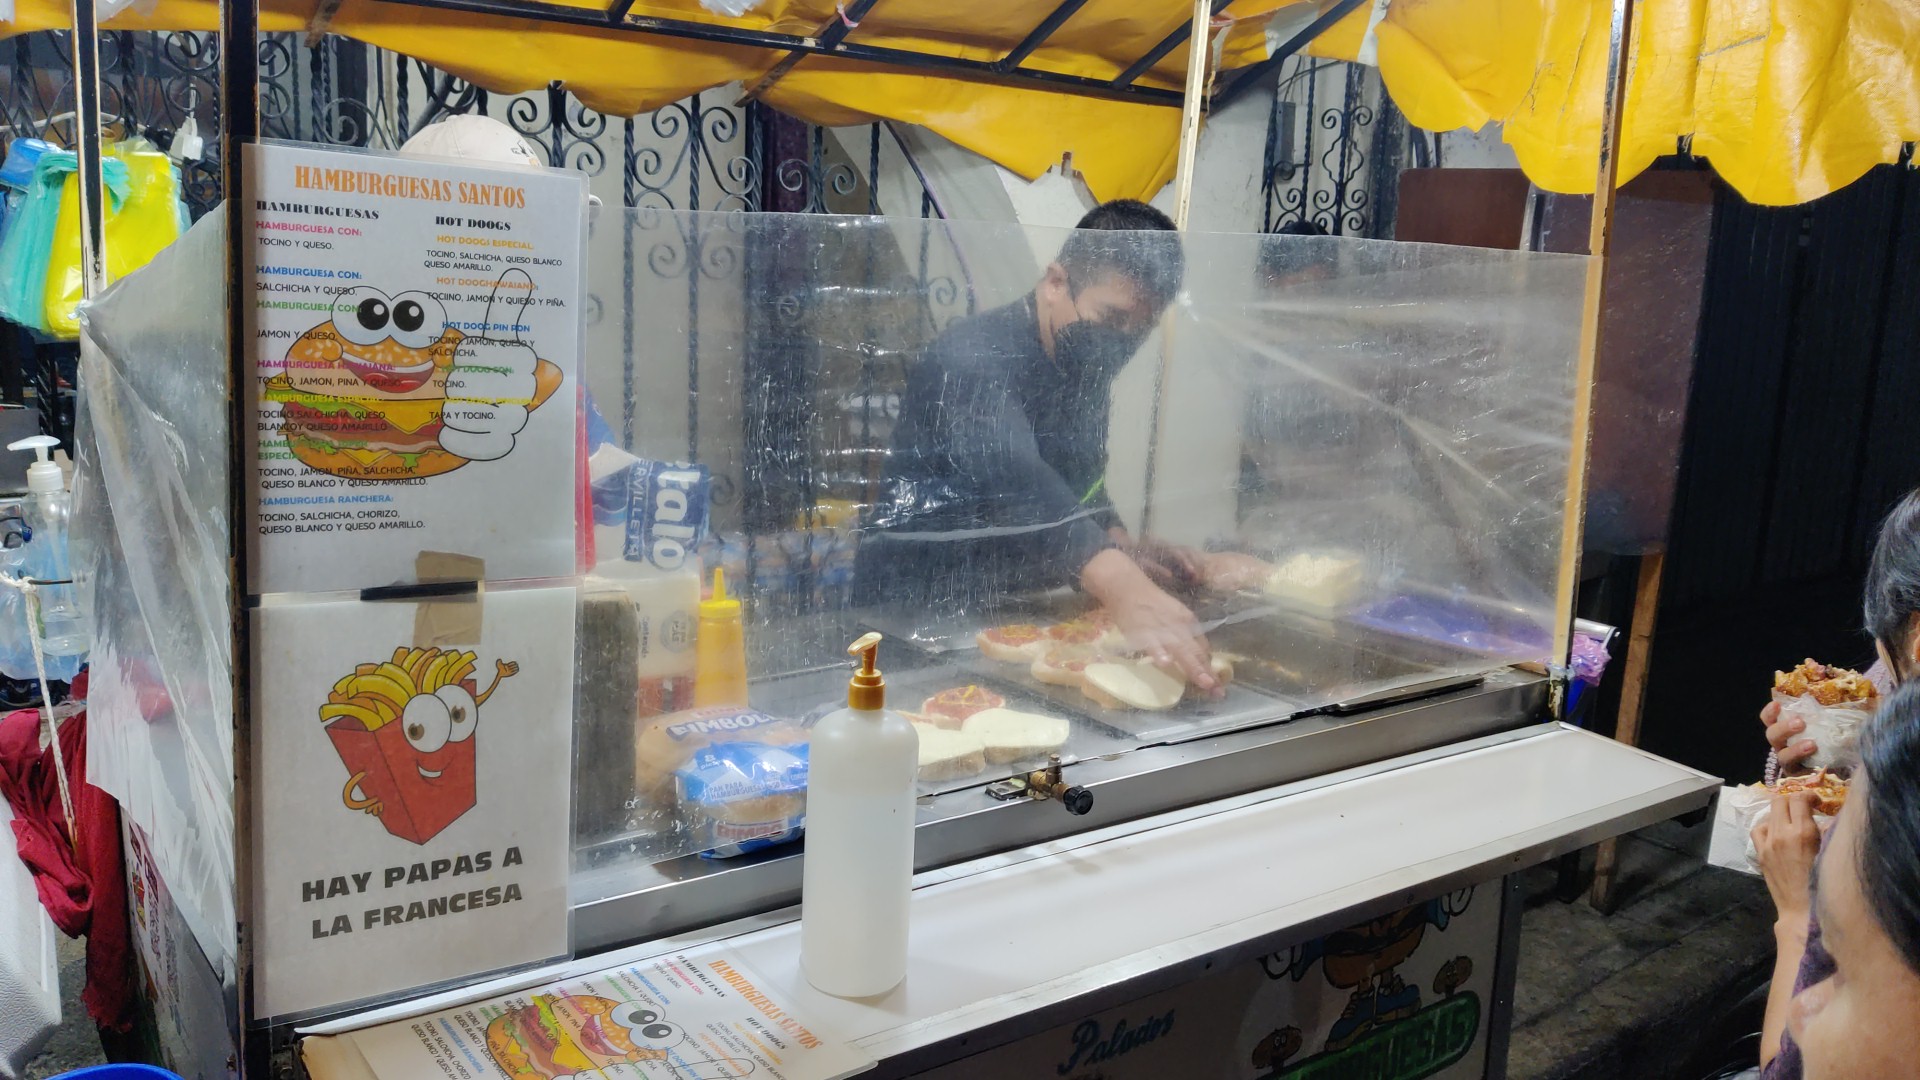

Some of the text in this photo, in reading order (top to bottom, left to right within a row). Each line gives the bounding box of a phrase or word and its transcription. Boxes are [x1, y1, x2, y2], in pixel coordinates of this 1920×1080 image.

[294, 165, 526, 209] HAMBURGUESAS SANTOS
[256, 200, 380, 220] HAMBURGUESAS
[256, 220, 363, 237] HAMBURGUESA CON:
[435, 215, 511, 231] HOT DOOGS
[259, 237, 292, 247] TOCINO
[302, 241, 334, 250] QUESO.
[436, 235, 456, 244] HOT
[458, 236, 490, 247] DOOGS
[426, 249, 563, 267] TOCINO, SALCHICHA, QUESO BLANCO
[256, 265, 363, 280] HAMBURGUESA CON:
[424, 260, 494, 273] QUESO AMARILLO.
[436, 276, 456, 286] HOT
[256, 282, 311, 293] SALCHICHA
[314, 285, 320, 293] Y
[256, 300, 334, 312] HAMBURGUESA
[466, 294, 495, 303] JAMON
[497, 295, 503, 303] Y
[506, 296, 536, 306] QUIESO
[538, 297, 544, 306] Y
[442, 321, 461, 330] HOT
[463, 322, 491, 331] DOOG
[493, 323, 509, 332] PIN
[256, 329, 291, 339] JAMON
[294, 330, 300, 339] Y
[465, 337, 497, 347] JAMON,
[499, 338, 527, 348] QUESO
[257, 359, 335, 369] HAMBURGUESA
[257, 376, 297, 386] TOCINO,
[299, 376, 335, 387] JAMON,
[337, 378, 359, 387] PINA
[433, 379, 467, 389] TOCINO.
[454, 412, 460, 420] Y
[462, 412, 496, 420] TOCINO.
[306, 422, 339, 431] QUESO
[258, 468, 297, 477] TOCINO,
[261, 477, 428, 490] QUESO BLANCO Y QUESO AMARILLO.
[258, 494, 394, 506] HAMBURGUESA RANCHERA:
[258, 509, 400, 522] TOCINO, SALCHICHA, CHORIZO,
[259, 520, 426, 536] QUESO BLANCO Y QUESO AMARILLO.
[709, 781, 743, 793] PAN PARA
[301, 846, 523, 903] HAY PAPAS A
[312, 883, 523, 940] LA FRANCESA
[707, 959, 823, 1050] HAMBURGUESAS SANTOS
